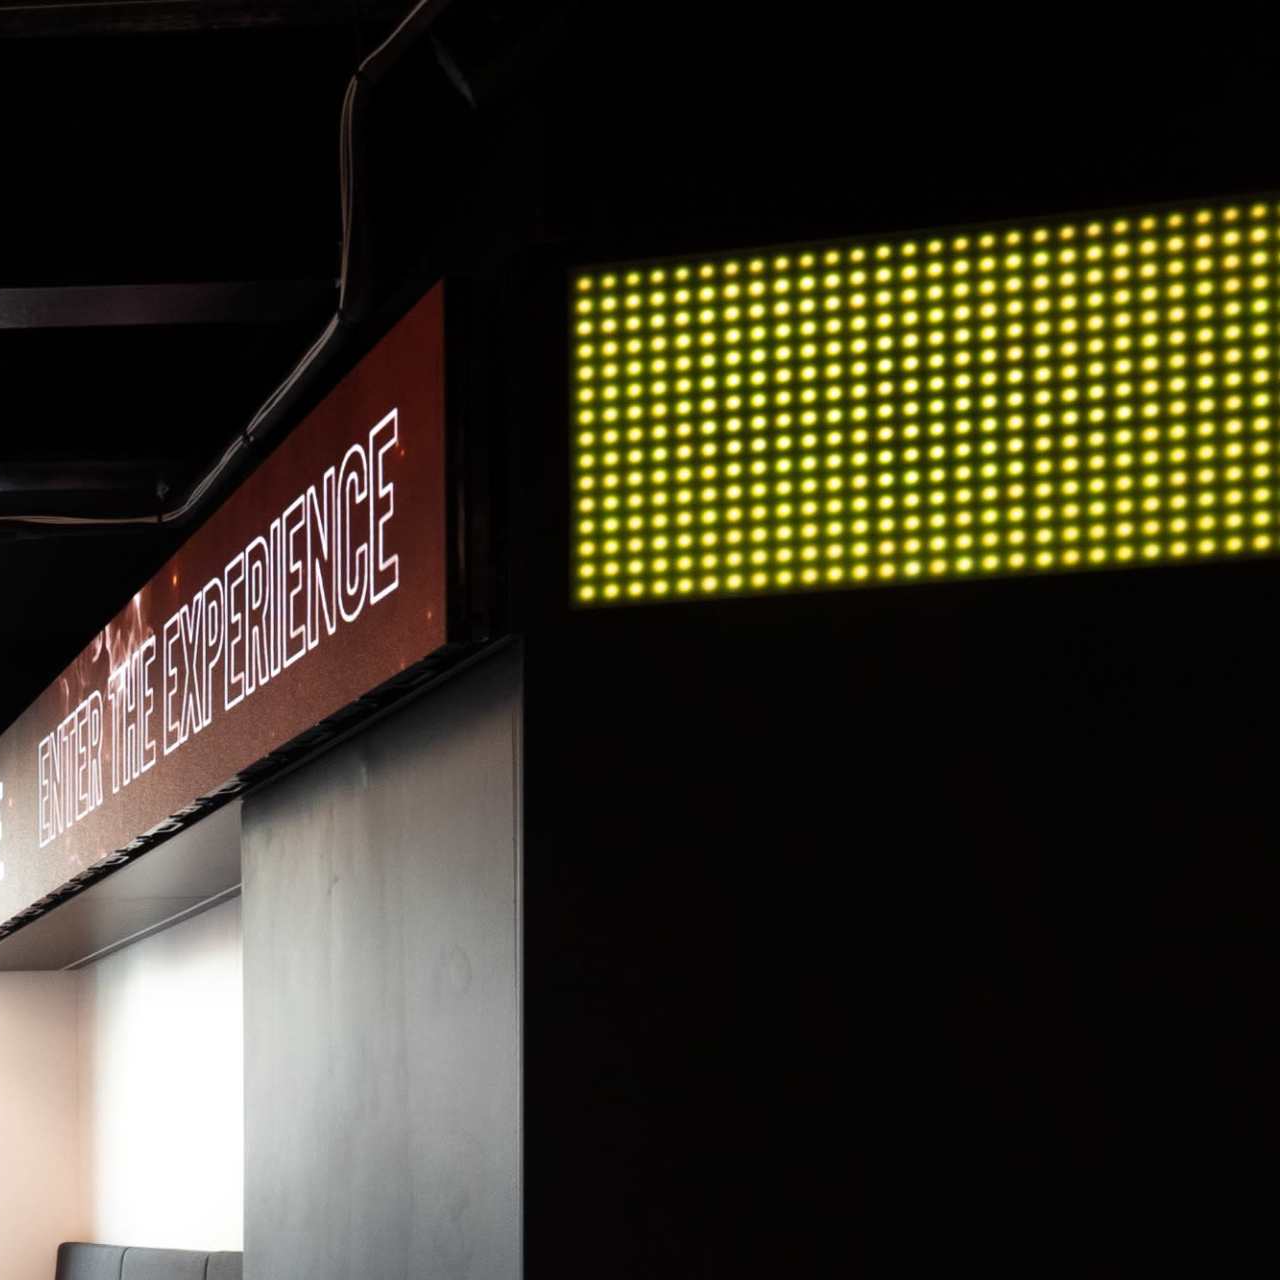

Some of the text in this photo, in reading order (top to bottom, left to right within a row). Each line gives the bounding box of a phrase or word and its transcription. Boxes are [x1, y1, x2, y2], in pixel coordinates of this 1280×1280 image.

[38, 407, 399, 849] ENTER THE EXPERIENCE
